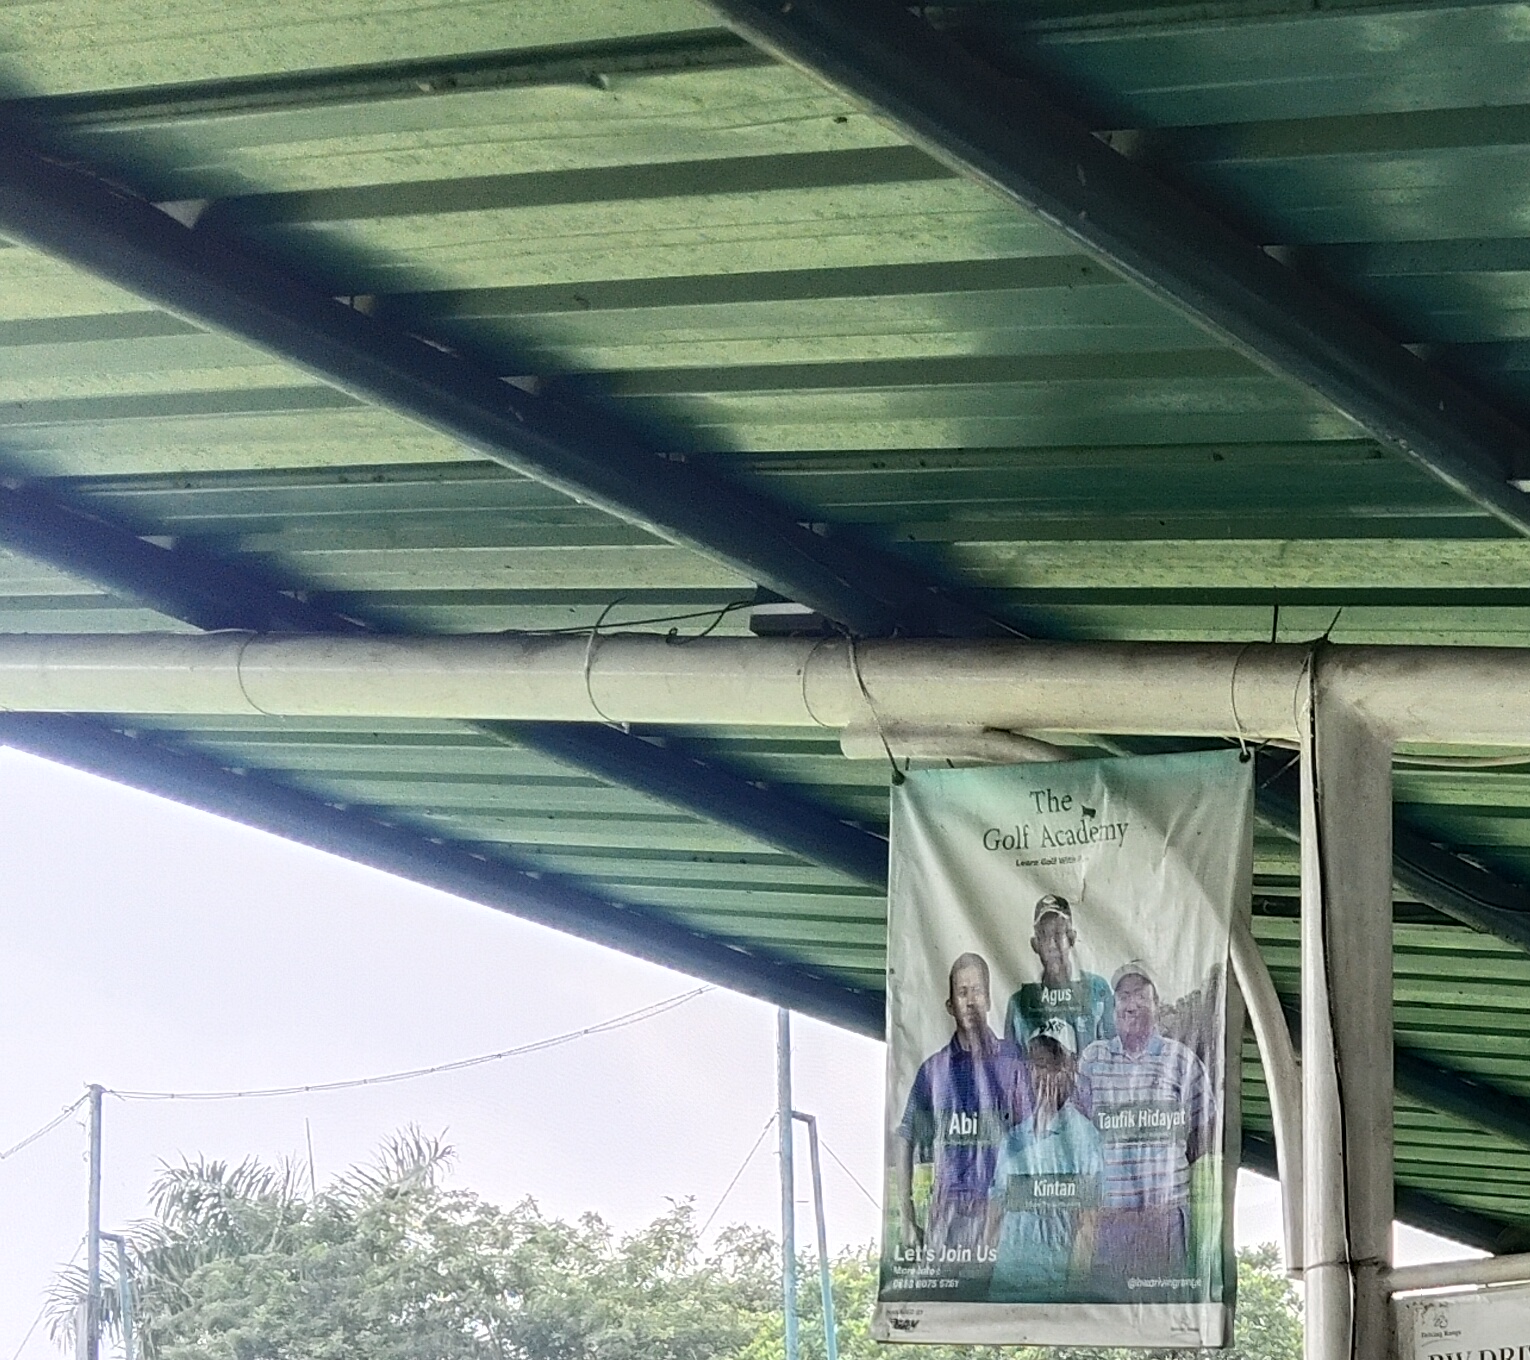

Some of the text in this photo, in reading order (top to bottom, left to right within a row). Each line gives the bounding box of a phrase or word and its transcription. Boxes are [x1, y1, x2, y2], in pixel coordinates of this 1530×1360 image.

[1030, 789, 1073, 814] The
[983, 819, 1129, 850] Golf Academy
[1041, 987, 1072, 1005] Agus
[949, 1112, 978, 1135] Abi
[1098, 1108, 1186, 1130] Taufik Hidayat
[1033, 1180, 1075, 1197] Kintan
[894, 1244, 998, 1262] Let's Join Us
